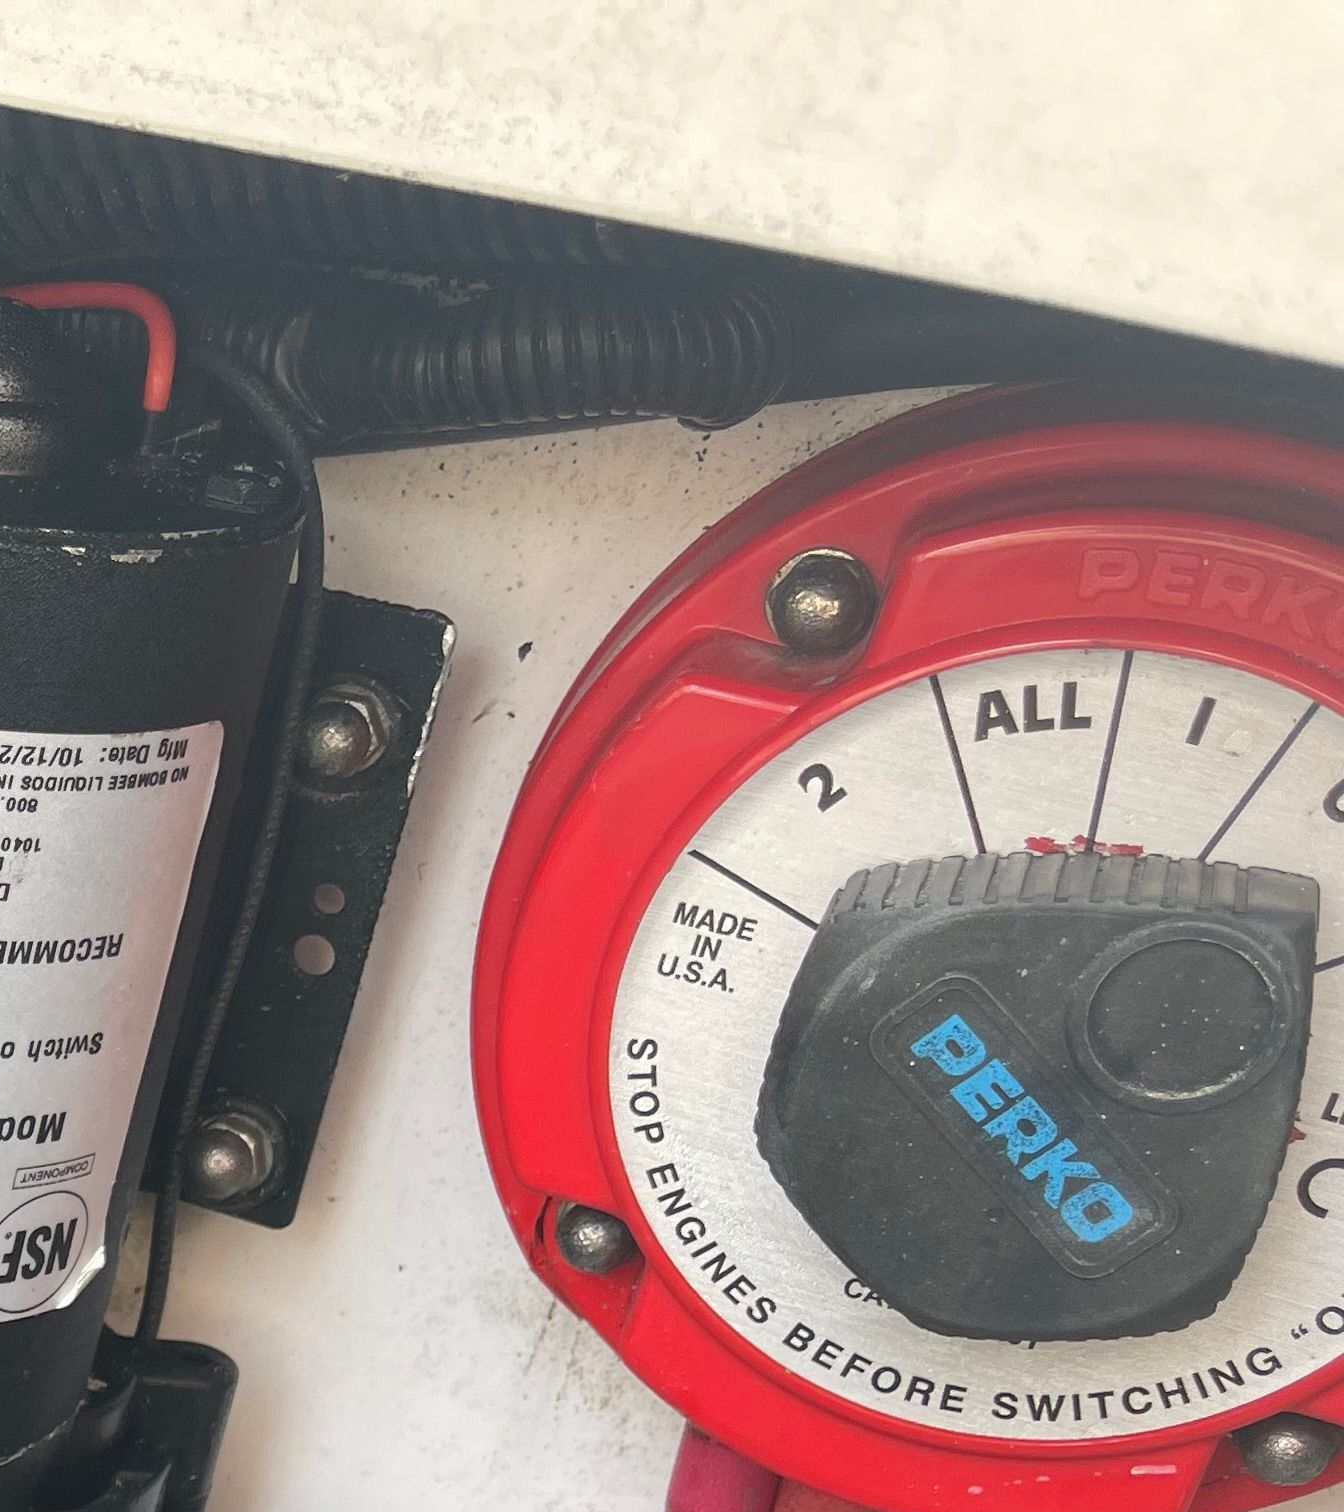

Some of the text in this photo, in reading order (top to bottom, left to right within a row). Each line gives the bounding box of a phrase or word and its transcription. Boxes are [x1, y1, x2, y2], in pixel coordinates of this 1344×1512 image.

[974, 682, 1092, 741] ALL
[100, 744, 150, 764] Date:
[157, 738, 188, 759] Mfg
[21, 776, 103, 792] LIQUIDOS
[107, 772, 168, 791] BOMBEE
[172, 766, 189, 782] NO
[799, 763, 847, 812] 2
[1, 837, 41, 853] 1040
[672, 901, 758, 940] MADE
[691, 932, 721, 960] IN
[656, 953, 735, 993] U.S.A.
[27, 1032, 104, 1062] Switch
[911, 1014, 1133, 1241] PERKO
[21, 1161, 89, 1183] COMPONENT
[627, 1038, 664, 1144] STOP
[647, 1163, 776, 1323] ENGINES
[782, 1323, 968, 1412] BEFORE
[991, 1347, 1282, 1421] SWITCHING
